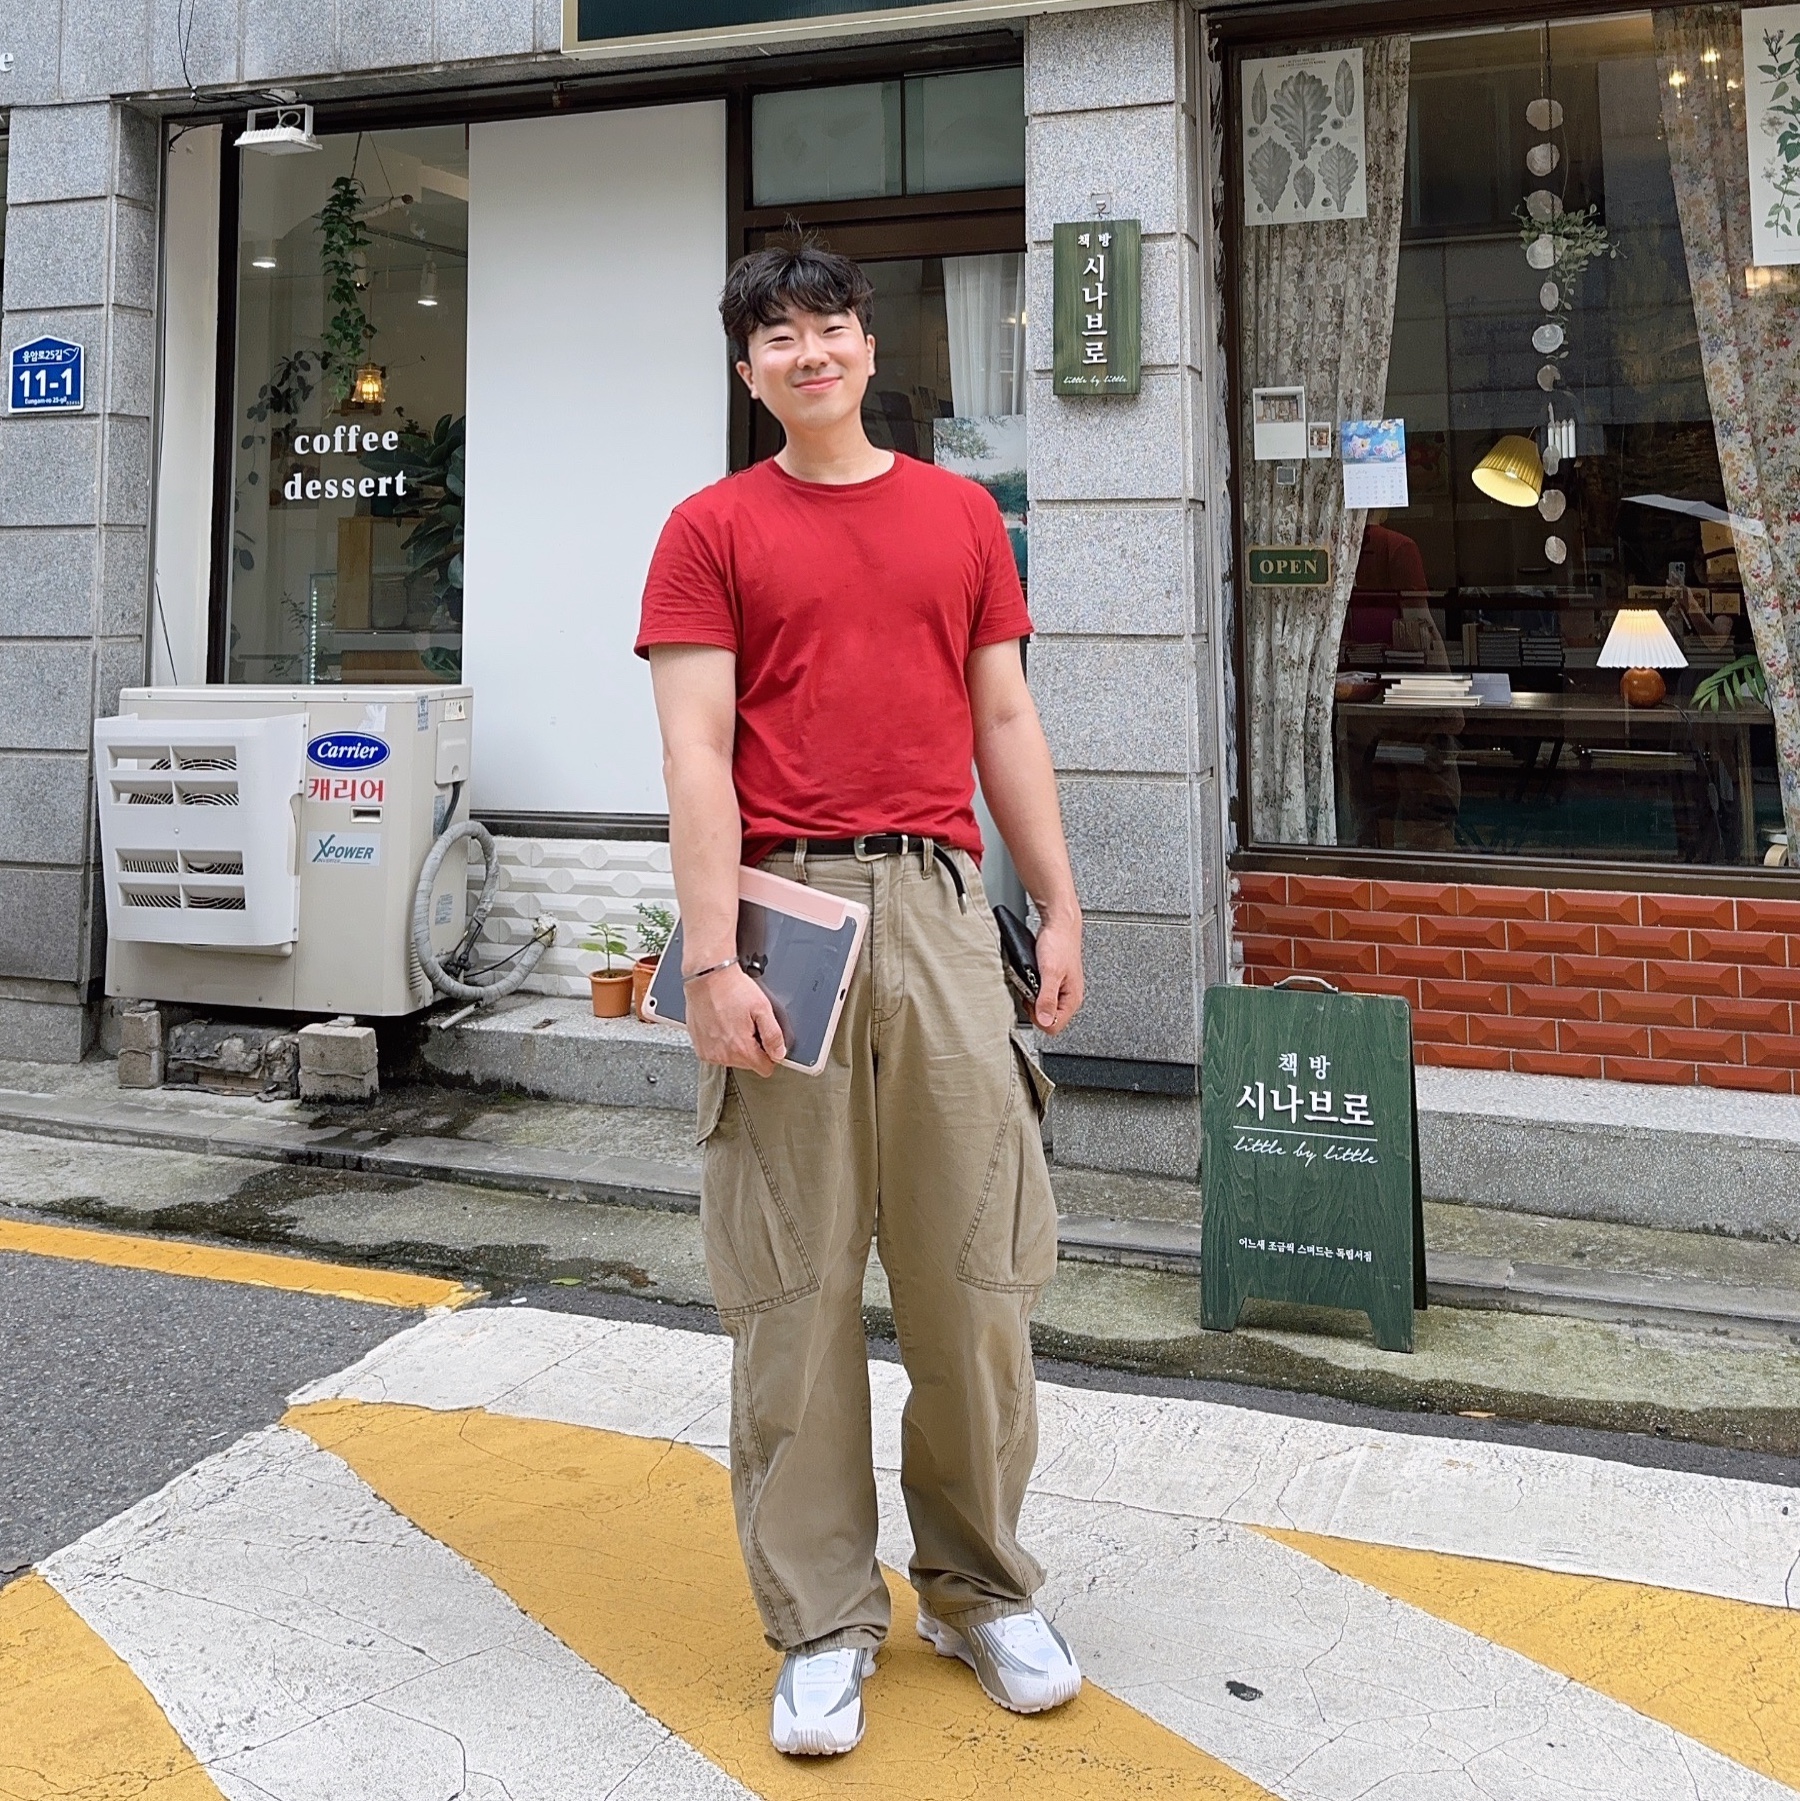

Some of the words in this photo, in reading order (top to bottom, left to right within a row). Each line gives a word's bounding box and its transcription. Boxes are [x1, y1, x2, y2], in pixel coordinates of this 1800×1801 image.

[1082, 254, 1108, 364] 시나브로
[22, 350, 62, 363] 응암로25길
[19, 368, 72, 397] 11-1
[1063, 376, 1087, 384] little
[1090, 375, 1100, 387] by
[1104, 375, 1127, 383] little
[294, 424, 399, 455] coffee
[284, 470, 407, 500] dessert
[1259, 559, 1317, 574] OPEN
[317, 741, 378, 759] Carrier
[308, 778, 384, 802] 캐리어
[312, 834, 374, 863] XPOWER
[1236, 1081, 1374, 1125] 시나브로
[1233, 1136, 1286, 1155] little
[1293, 1141, 1317, 1168] by
[1323, 1146, 1378, 1164] little
[1238, 1237, 1265, 1250] 어느새
[1335, 1248, 1372, 1262] 독립서점
